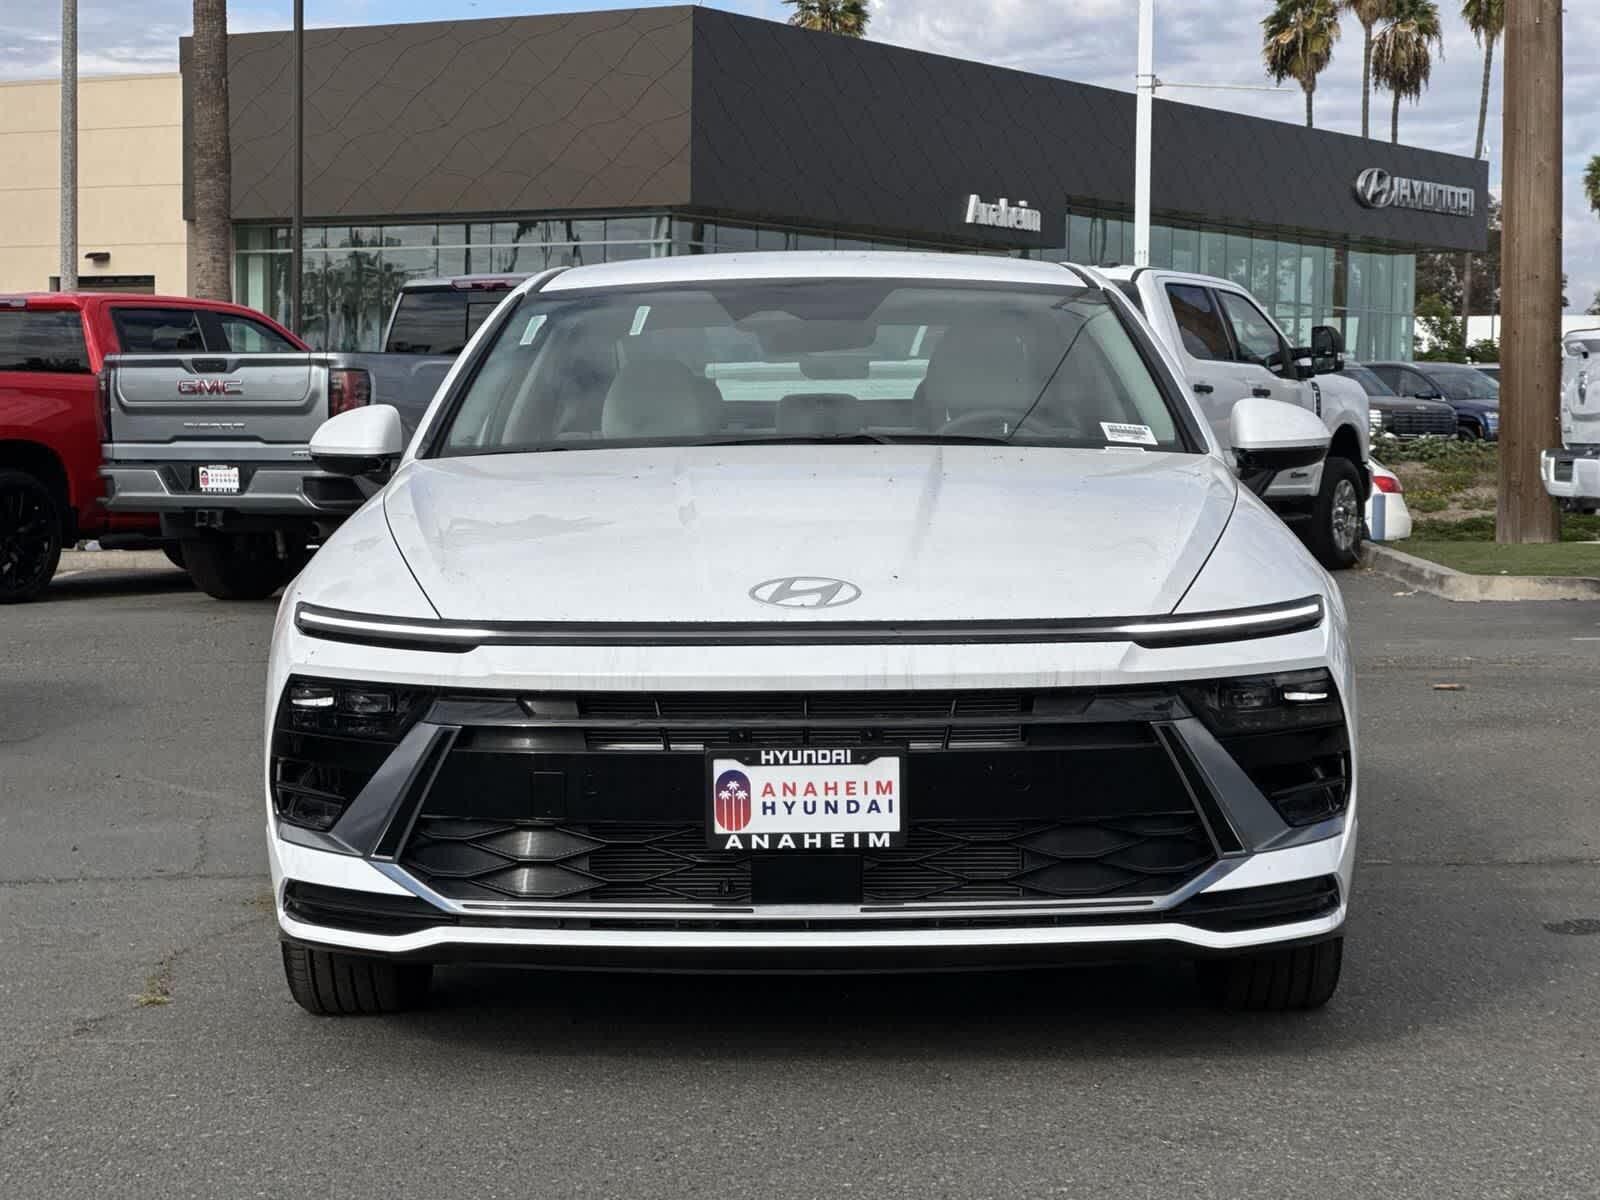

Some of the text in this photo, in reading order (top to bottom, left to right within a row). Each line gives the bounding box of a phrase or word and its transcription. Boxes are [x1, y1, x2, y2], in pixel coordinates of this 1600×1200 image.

[1393, 176, 1475, 217] HYUNDAI
[965, 194, 1041, 232] Anaheim
[176, 379, 244, 395] GMC
[761, 749, 851, 765] HYUNDAI
[762, 780, 893, 798] ANAHEIM
[762, 799, 893, 815] HYUNDAI
[725, 832, 890, 850] ANAHEIM
